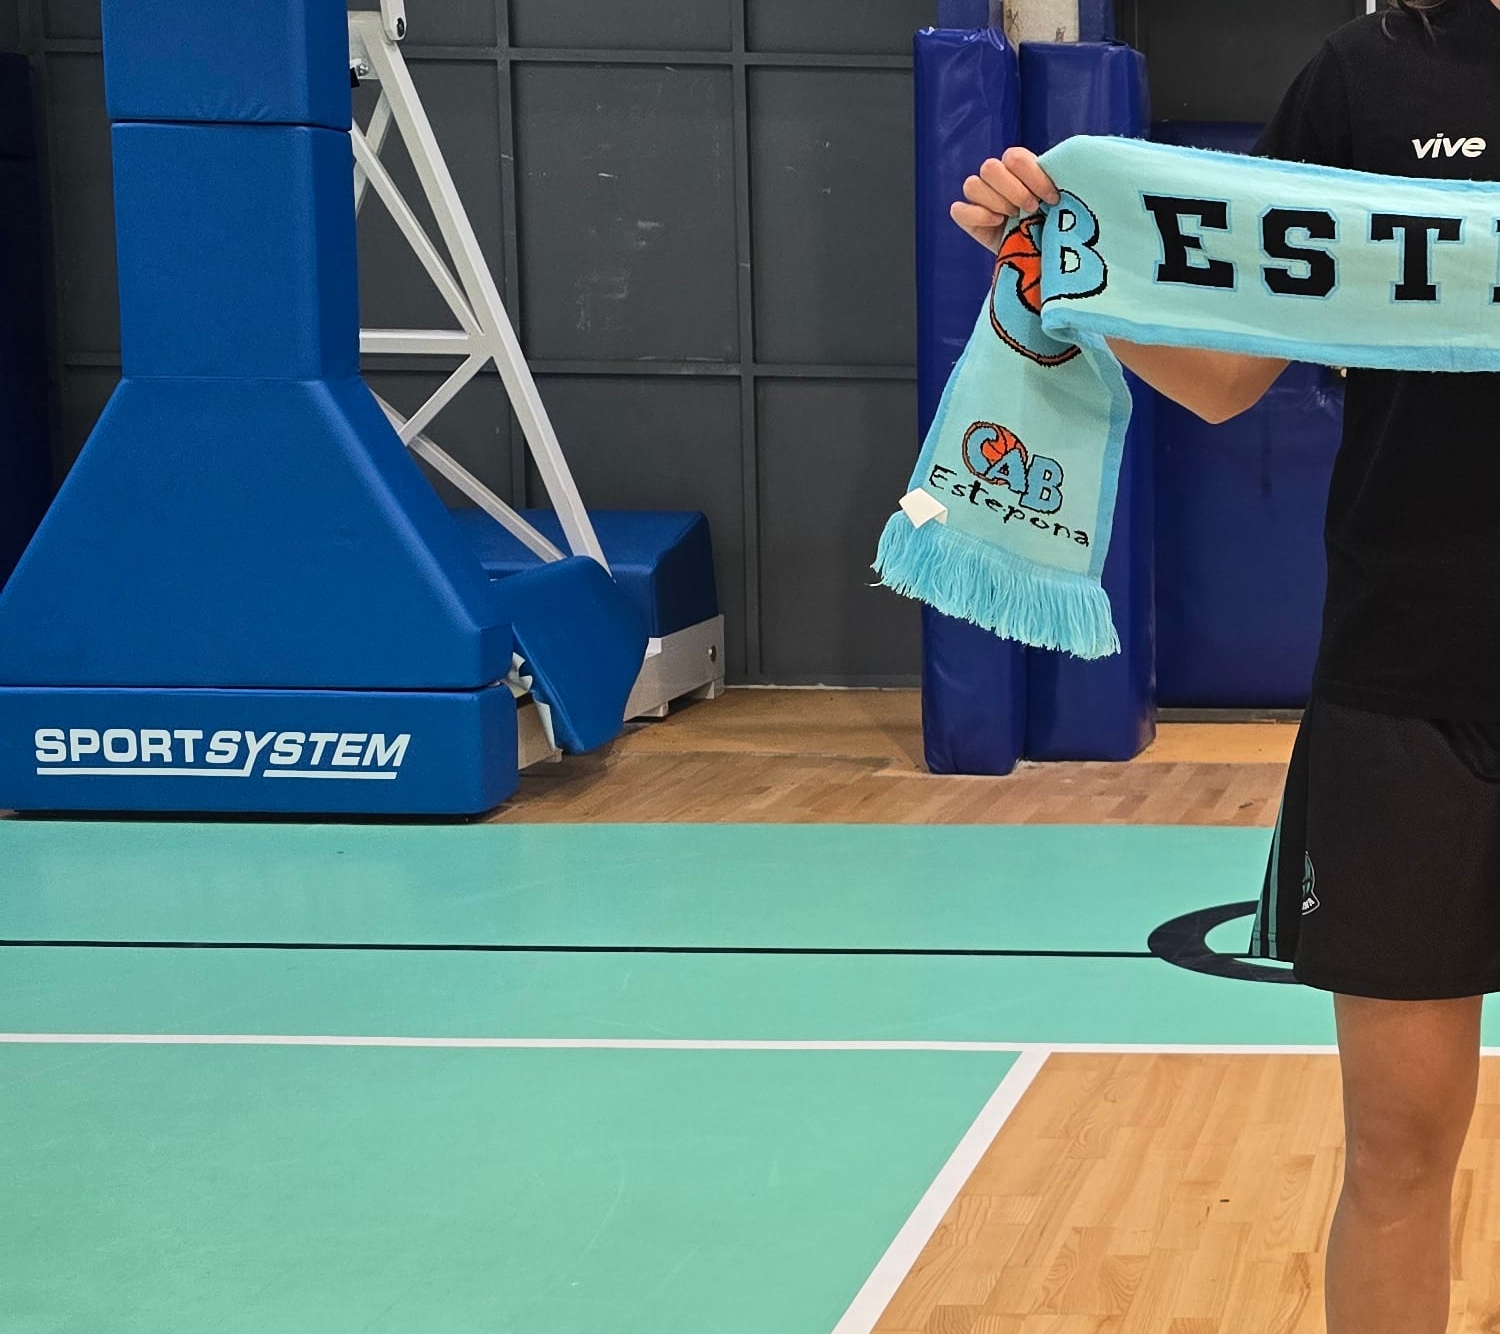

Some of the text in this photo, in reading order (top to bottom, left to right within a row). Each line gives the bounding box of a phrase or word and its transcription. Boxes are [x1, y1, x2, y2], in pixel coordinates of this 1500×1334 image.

[1411, 133, 1487, 159] vive
[929, 464, 1090, 547] Estepona
[961, 421, 1064, 514] CAB
